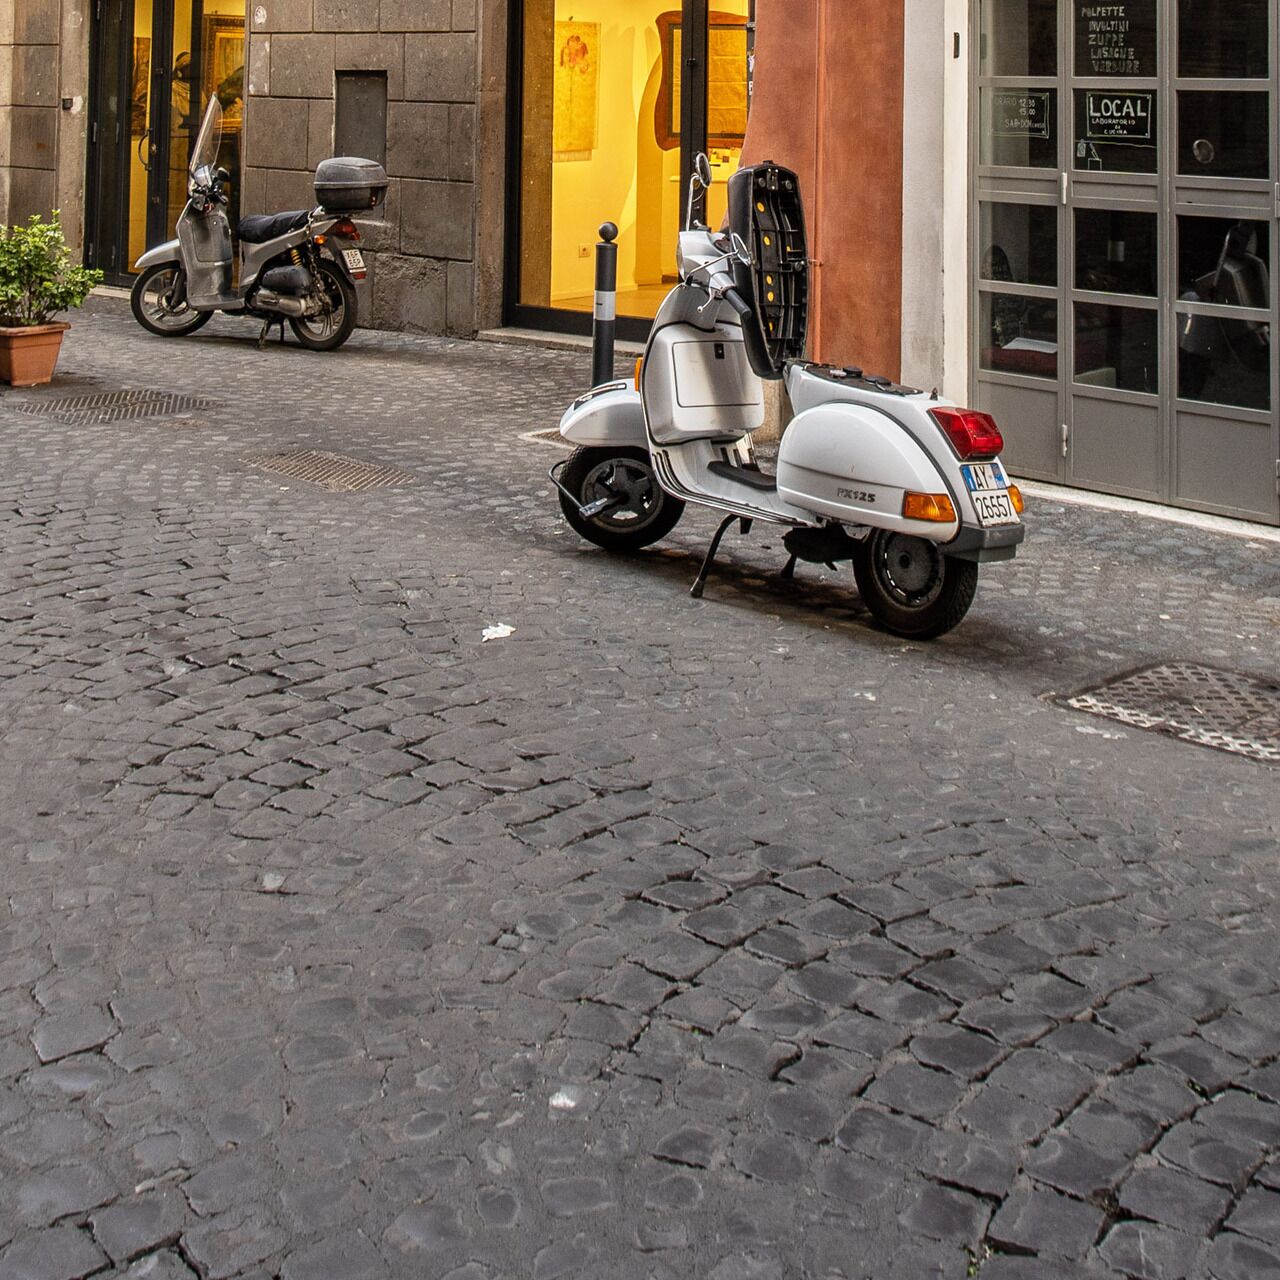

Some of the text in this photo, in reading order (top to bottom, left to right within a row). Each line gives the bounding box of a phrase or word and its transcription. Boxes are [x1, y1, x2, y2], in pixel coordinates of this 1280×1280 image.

[1081, 6, 1125, 17] POLPETTE
[1089, 20, 1129, 32] INVOLTINI
[1088, 34, 1124, 46] ZUPPE
[1090, 47, 1135, 60] LASAGNE
[1091, 60, 1140, 73] VERDURE
[1089, 96, 1147, 117] LOCAL
[1091, 118, 1136, 126] LABORATORIO
[973, 466, 989, 489] AY
[837, 488, 876, 503] PX125
[976, 494, 1012, 519] 26557
